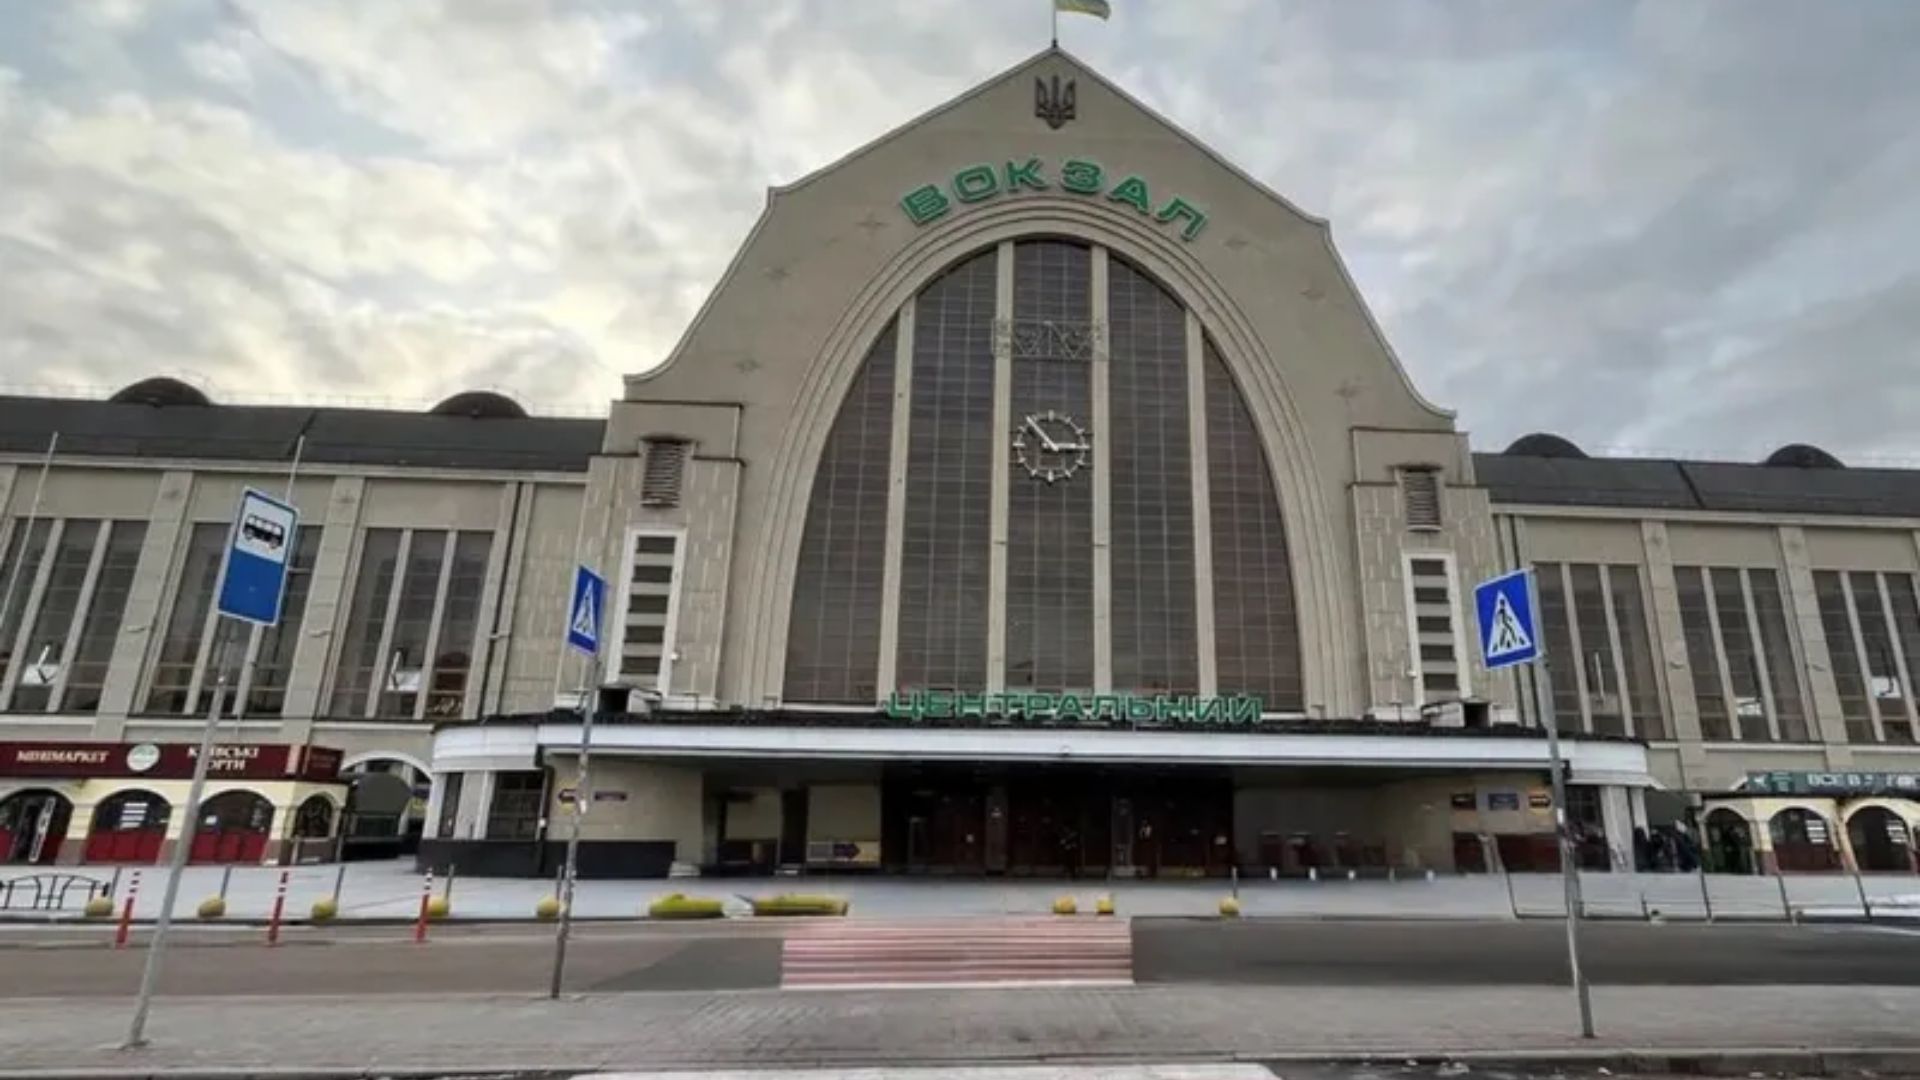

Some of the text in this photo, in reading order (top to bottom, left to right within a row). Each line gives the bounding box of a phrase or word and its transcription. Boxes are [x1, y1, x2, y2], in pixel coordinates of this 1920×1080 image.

[901, 158, 1207, 242] ВОКЗАЛ
[885, 691, 1263, 723] ЦЕНТРАЛЬНИЙ
[206, 759, 246, 770] ОРТИ
